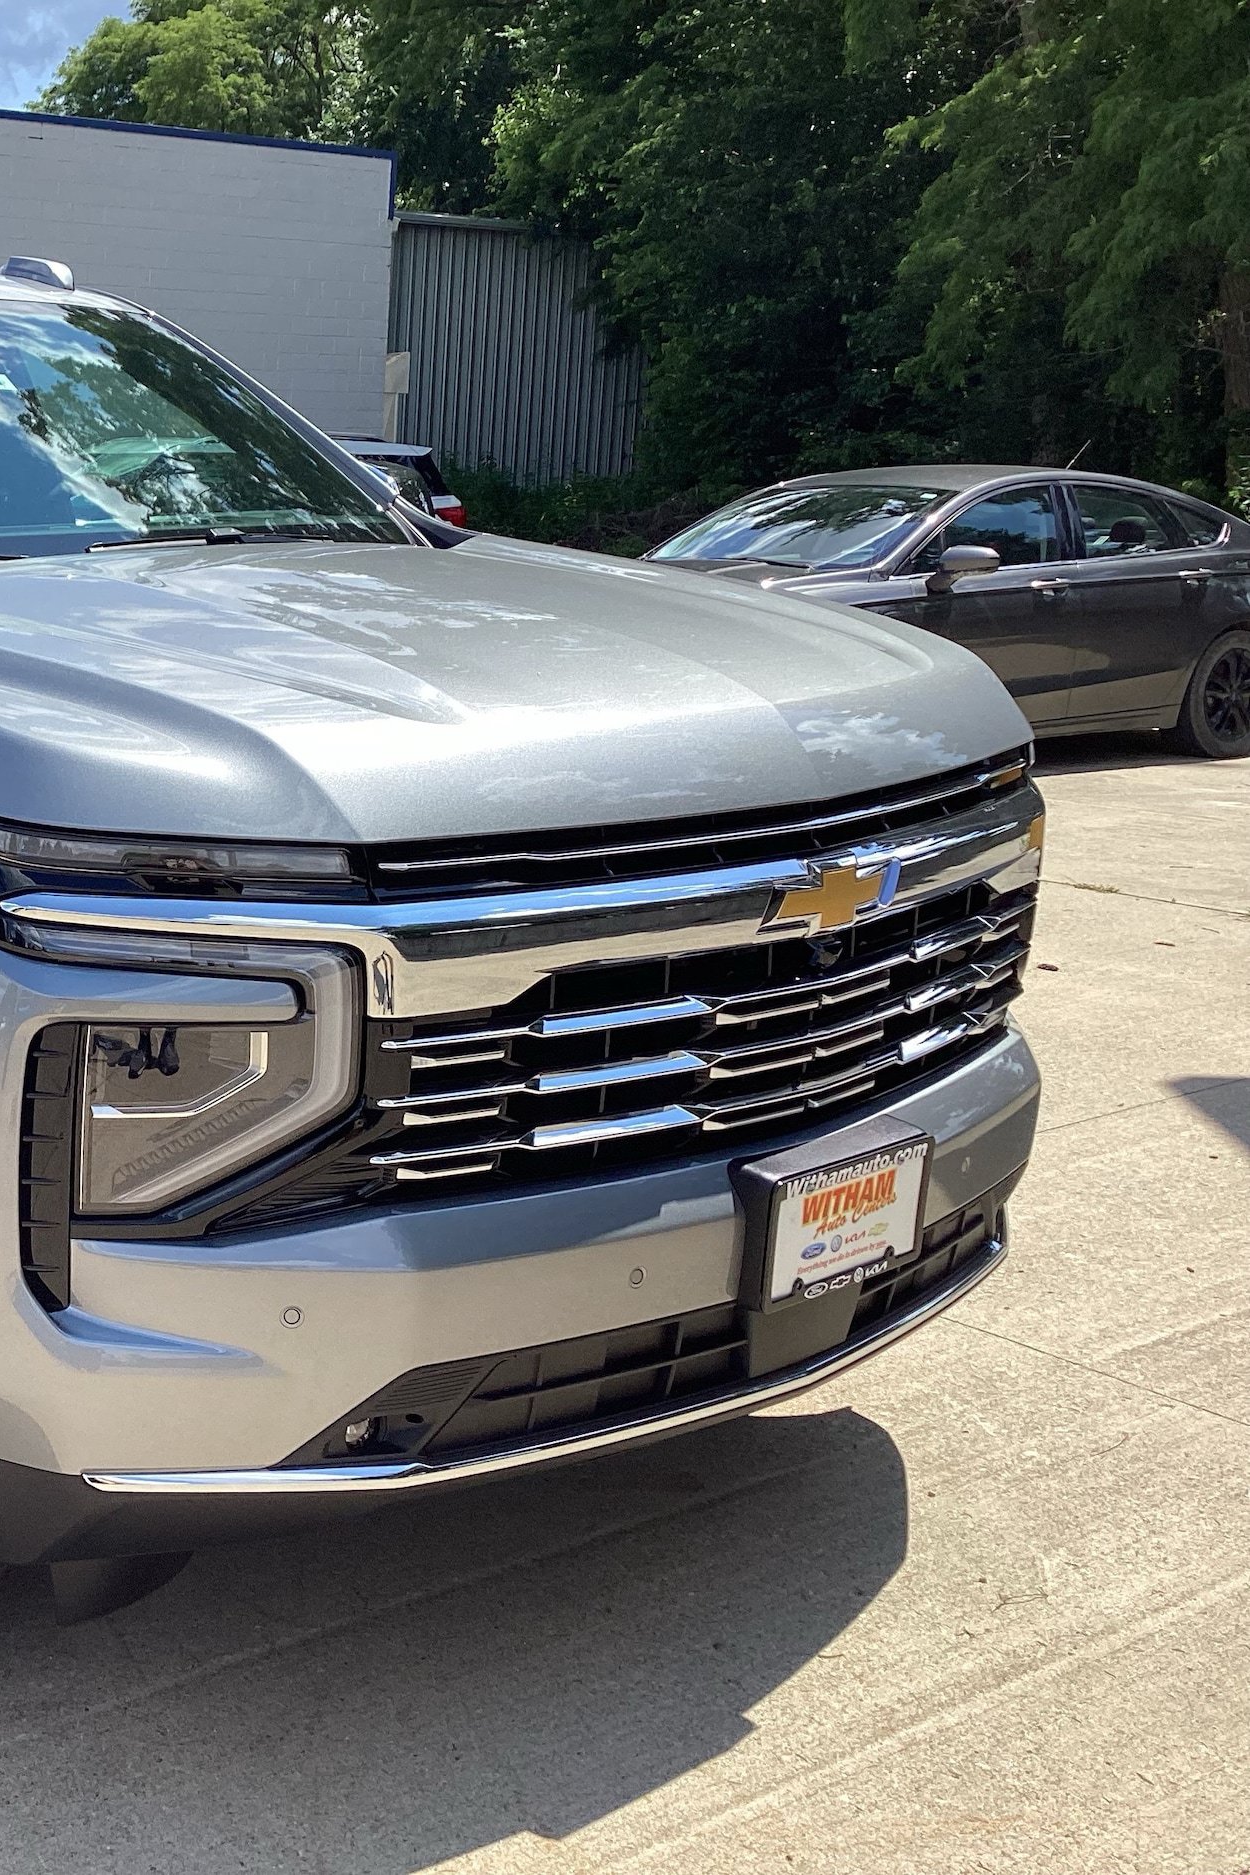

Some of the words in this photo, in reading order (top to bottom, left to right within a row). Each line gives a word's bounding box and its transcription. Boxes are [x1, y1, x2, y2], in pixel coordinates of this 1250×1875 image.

[786, 1142, 928, 1198] Withamauto.com
[801, 1168, 897, 1226] WITHAM
[813, 1215, 847, 1240] Auto
